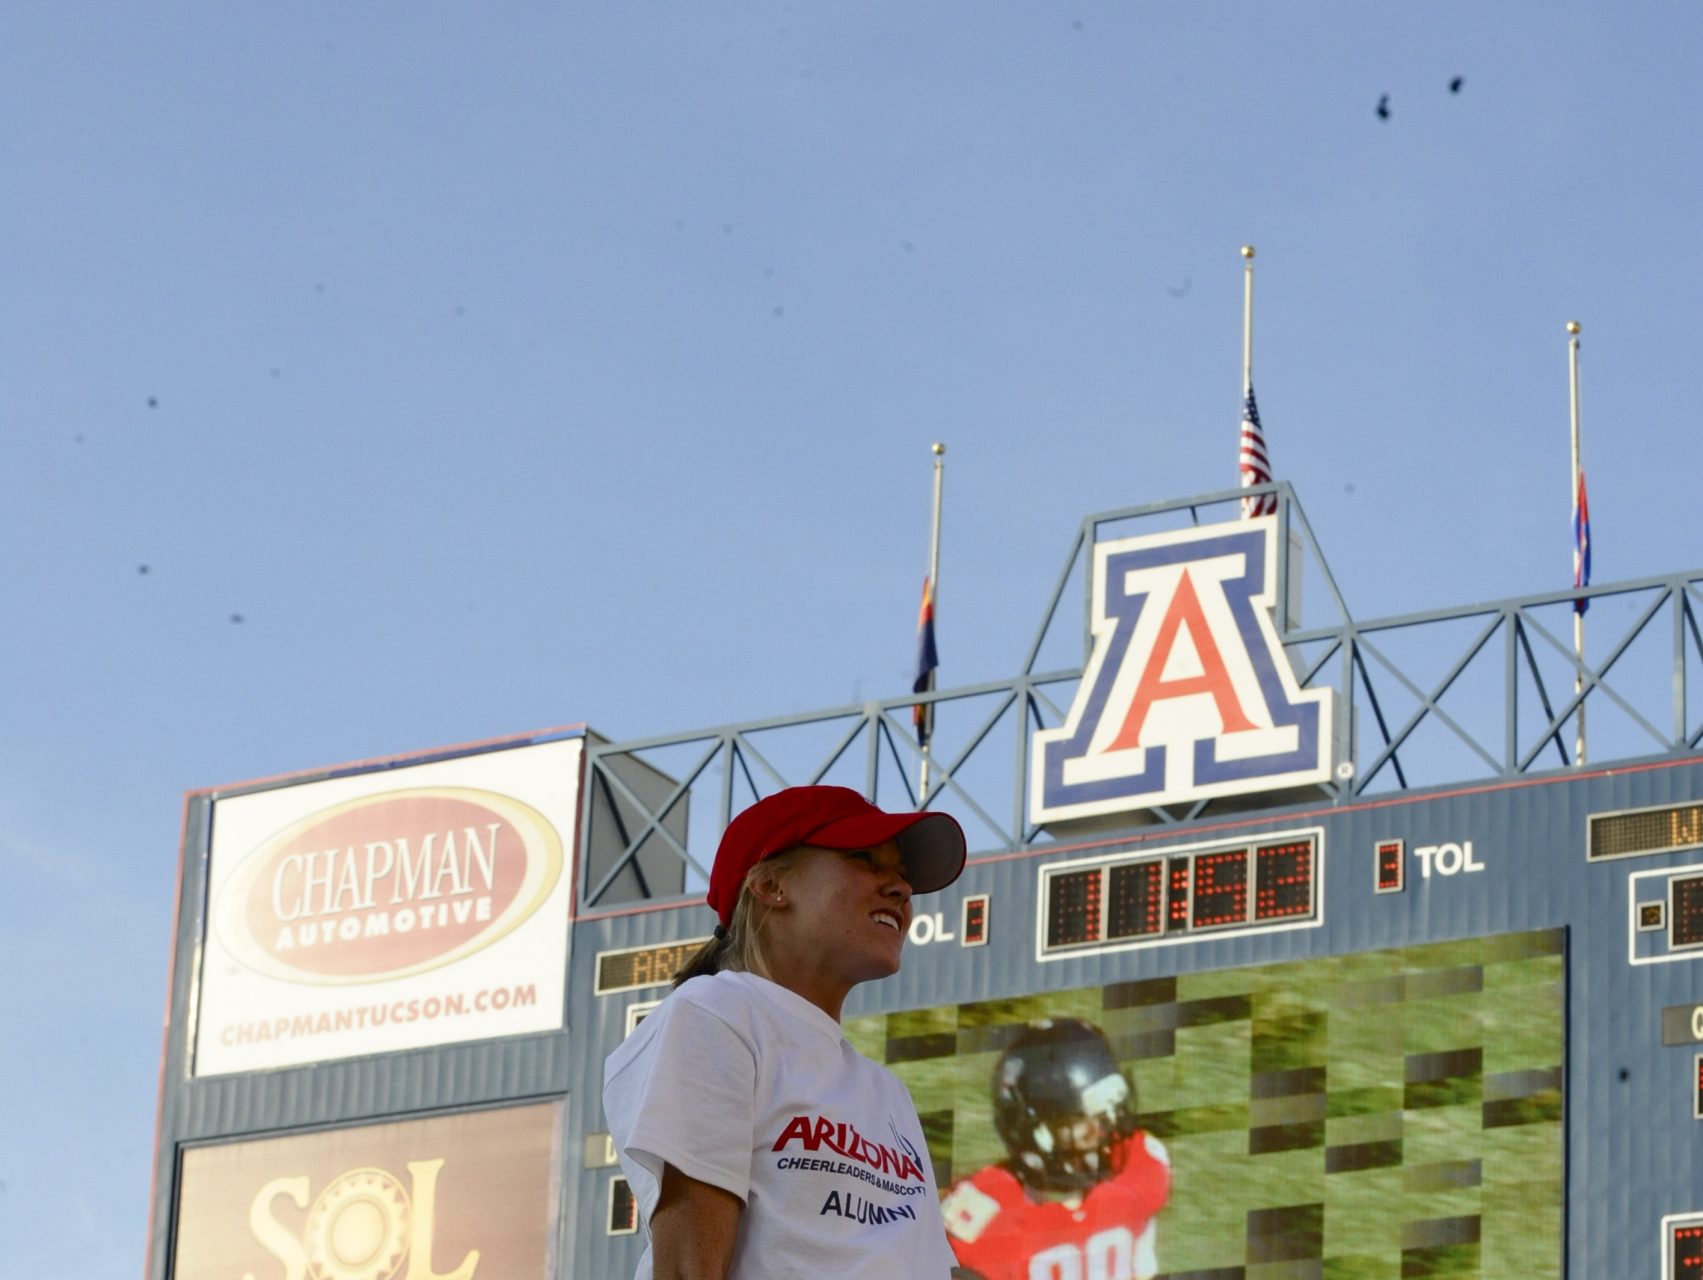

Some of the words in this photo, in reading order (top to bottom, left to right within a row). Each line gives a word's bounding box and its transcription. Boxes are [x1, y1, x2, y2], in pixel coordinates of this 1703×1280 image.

[1031, 514, 1332, 824] A
[272, 823, 500, 922] CHAPMAN
[1414, 841, 1485, 878] TOL
[275, 897, 492, 950] AUTOMOTIVE
[908, 911, 954, 946] OL
[220, 984, 537, 1047] CHAPMANTUCSON.COM
[771, 1115, 926, 1183] ARIZONA
[820, 1190, 916, 1225] ALUMNI
